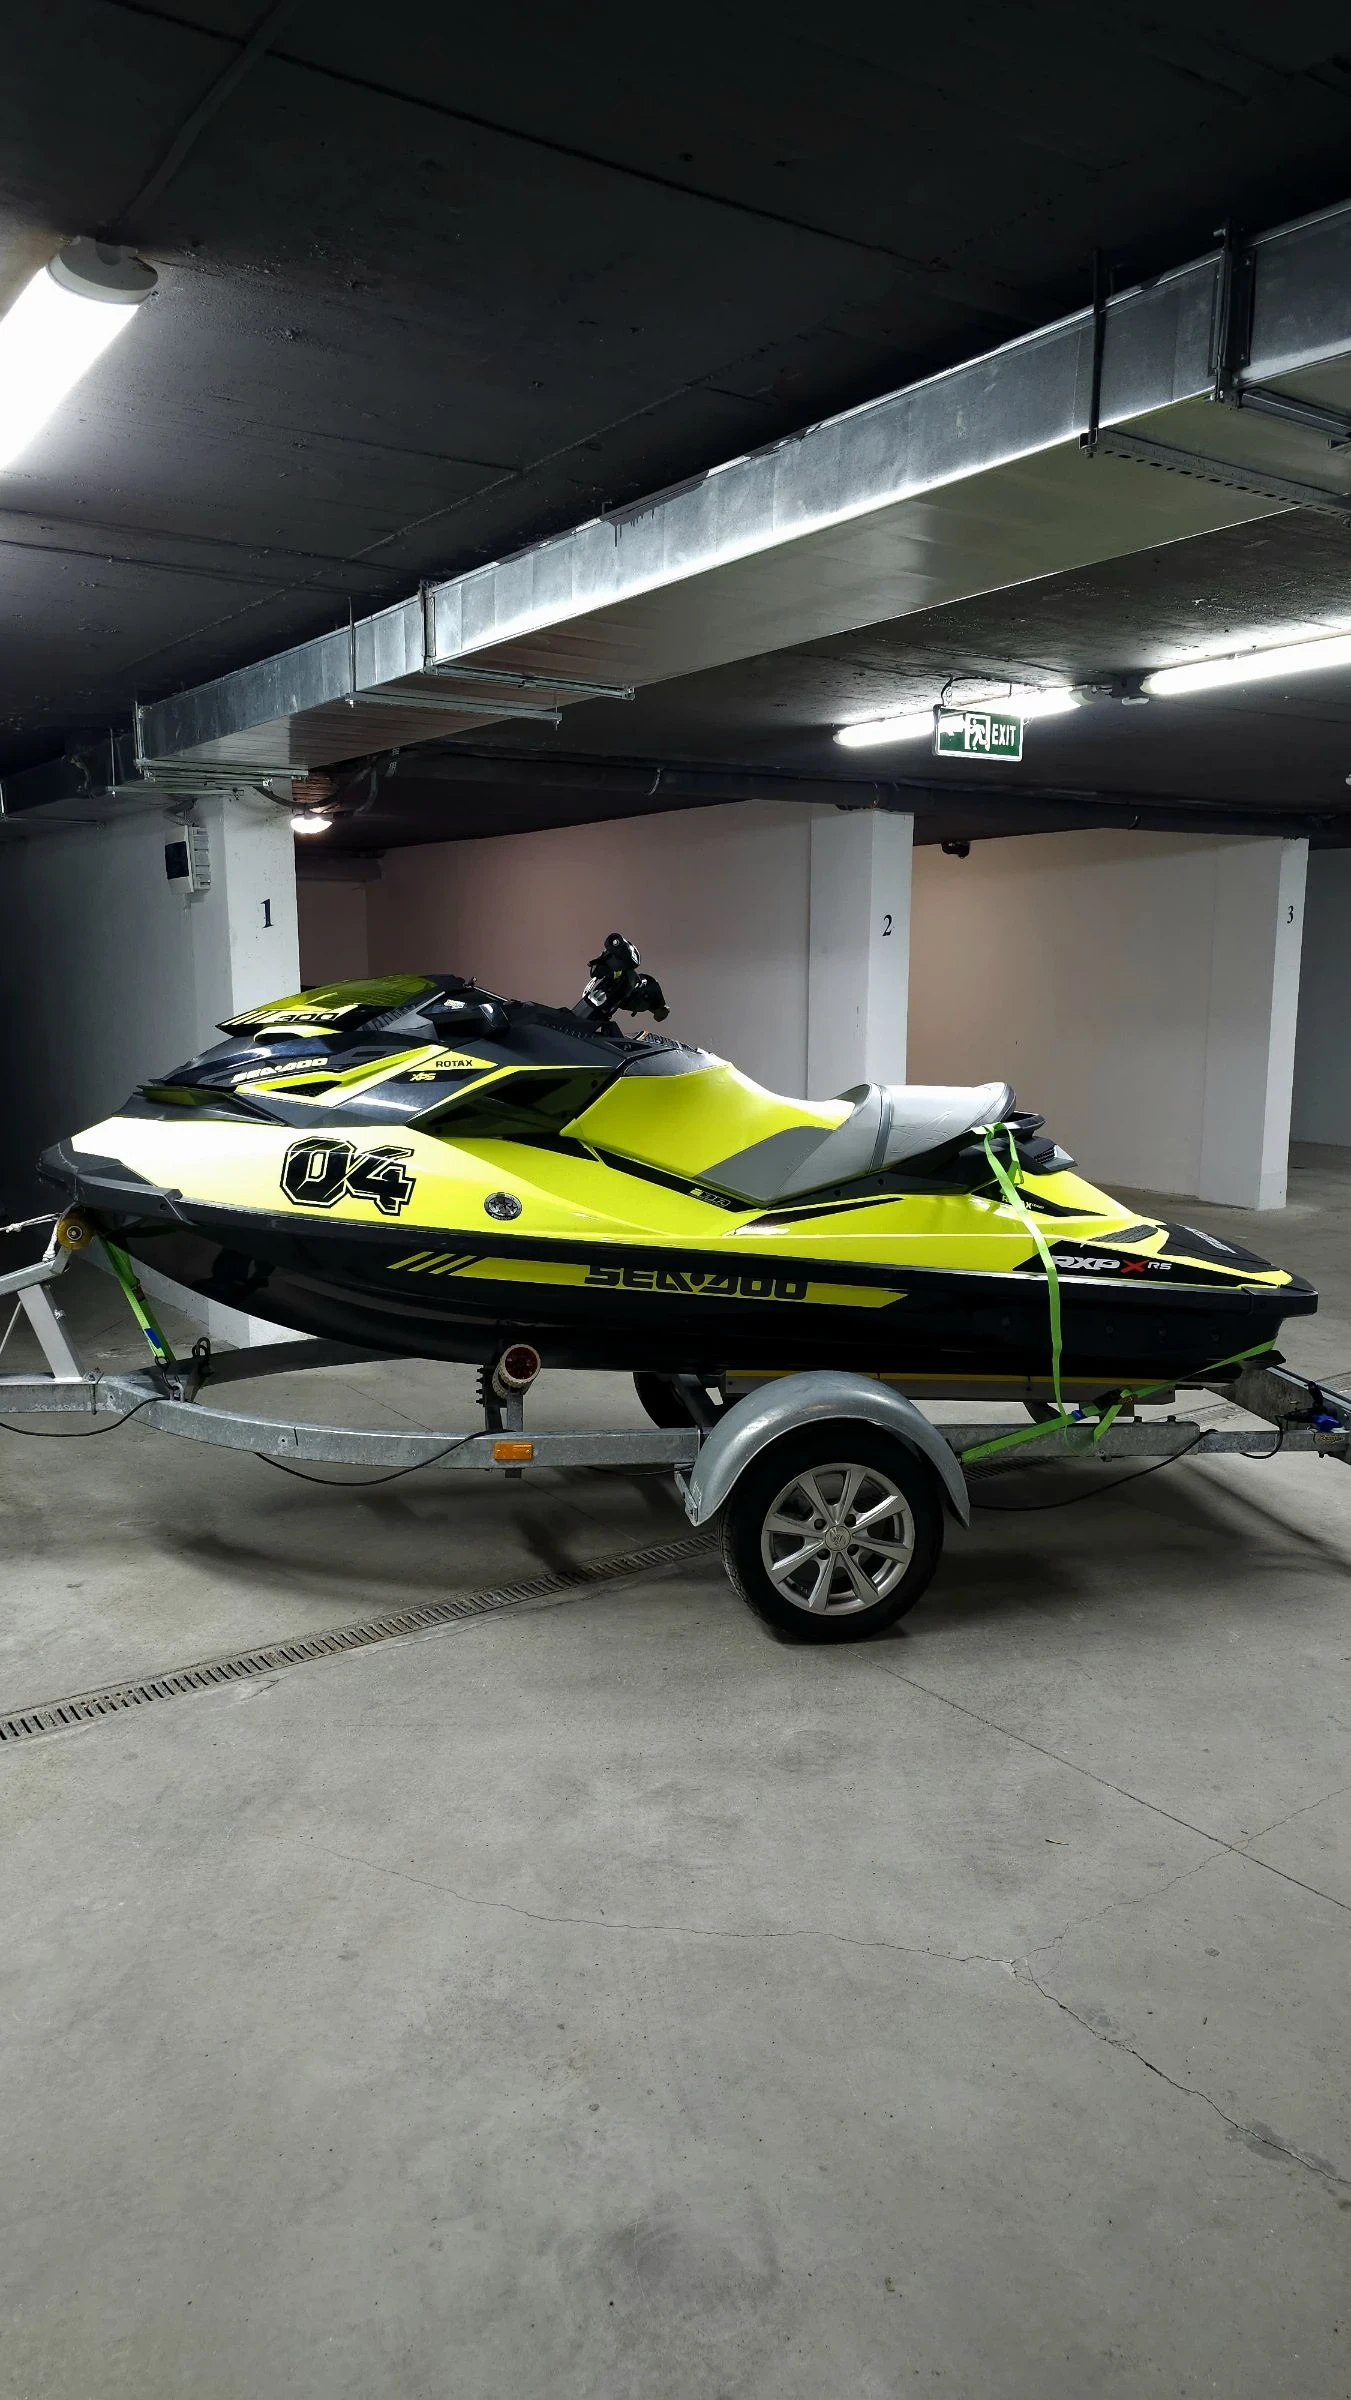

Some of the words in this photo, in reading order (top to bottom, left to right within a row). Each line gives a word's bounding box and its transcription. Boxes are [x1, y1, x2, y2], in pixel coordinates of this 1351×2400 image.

[991, 723, 1017, 747] EXIT
[260, 898, 274, 929] 1
[1286, 905, 1294, 924] 3
[882, 914, 893, 937] 2
[435, 1059, 473, 1068] ROTAX
[279, 1136, 416, 1216] 04
[1147, 1261, 1172, 1271] RS
